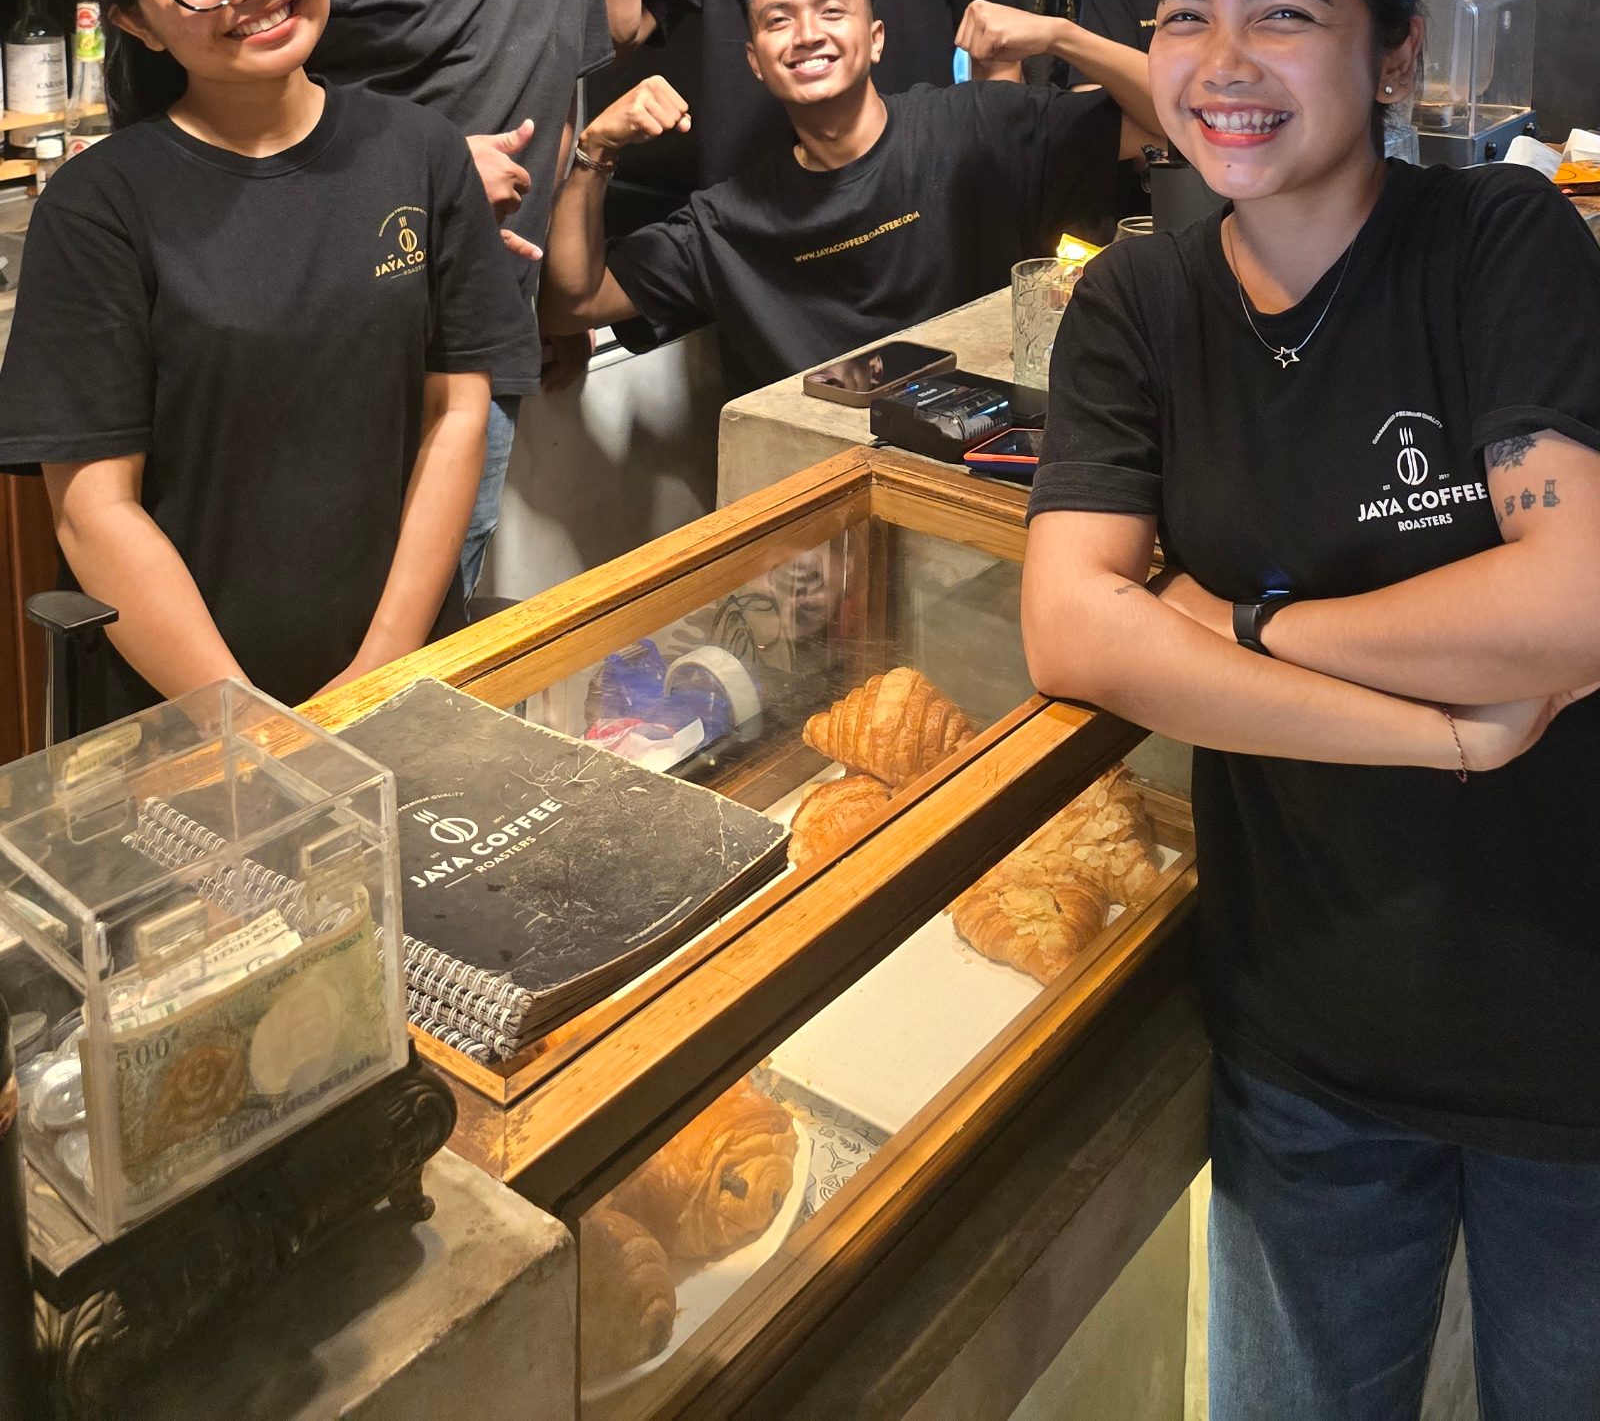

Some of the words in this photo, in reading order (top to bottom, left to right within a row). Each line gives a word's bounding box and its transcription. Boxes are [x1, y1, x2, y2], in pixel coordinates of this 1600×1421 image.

[793, 210, 920, 263] WWW.JAYACOFFEEROASTERS.COM
[375, 258, 406, 277] JAYA
[1357, 497, 1404, 522] JAYA
[1407, 482, 1488, 512] COFFEE
[1398, 512, 1454, 532] ROASTERS
[410, 856, 474, 889] JAYA
[470, 798, 563, 856] COFFEE
[474, 835, 537, 874] ROASTERS
[116, 1038, 169, 1073] 500
